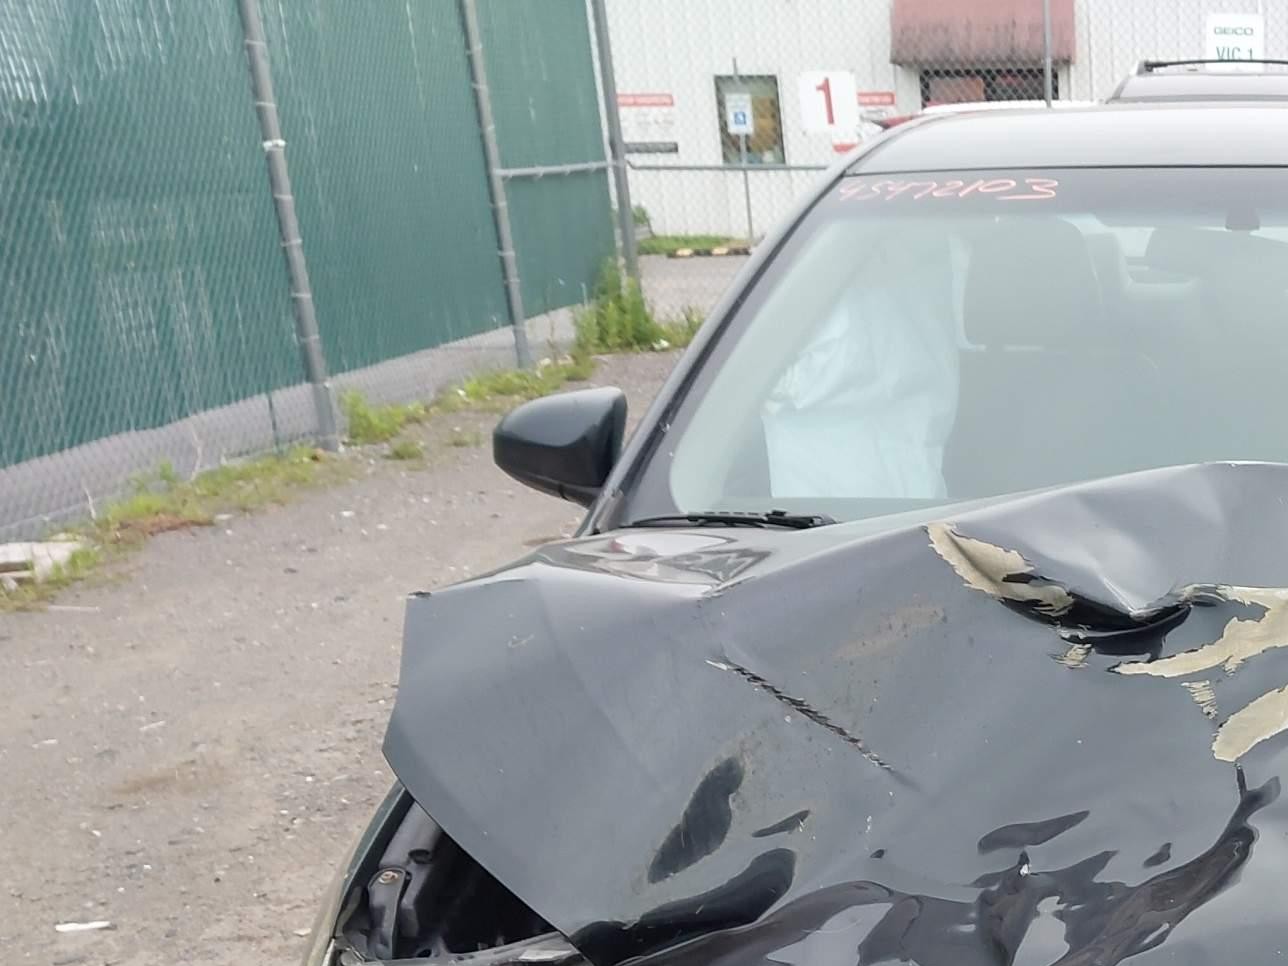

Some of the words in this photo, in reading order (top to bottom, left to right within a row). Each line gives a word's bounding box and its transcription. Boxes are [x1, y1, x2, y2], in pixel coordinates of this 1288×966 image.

[1214, 26, 1254, 36] GEICO
[1215, 46, 1241, 61] VIC
[1247, 47, 1254, 61] 1
[815, 77, 836, 126] 1
